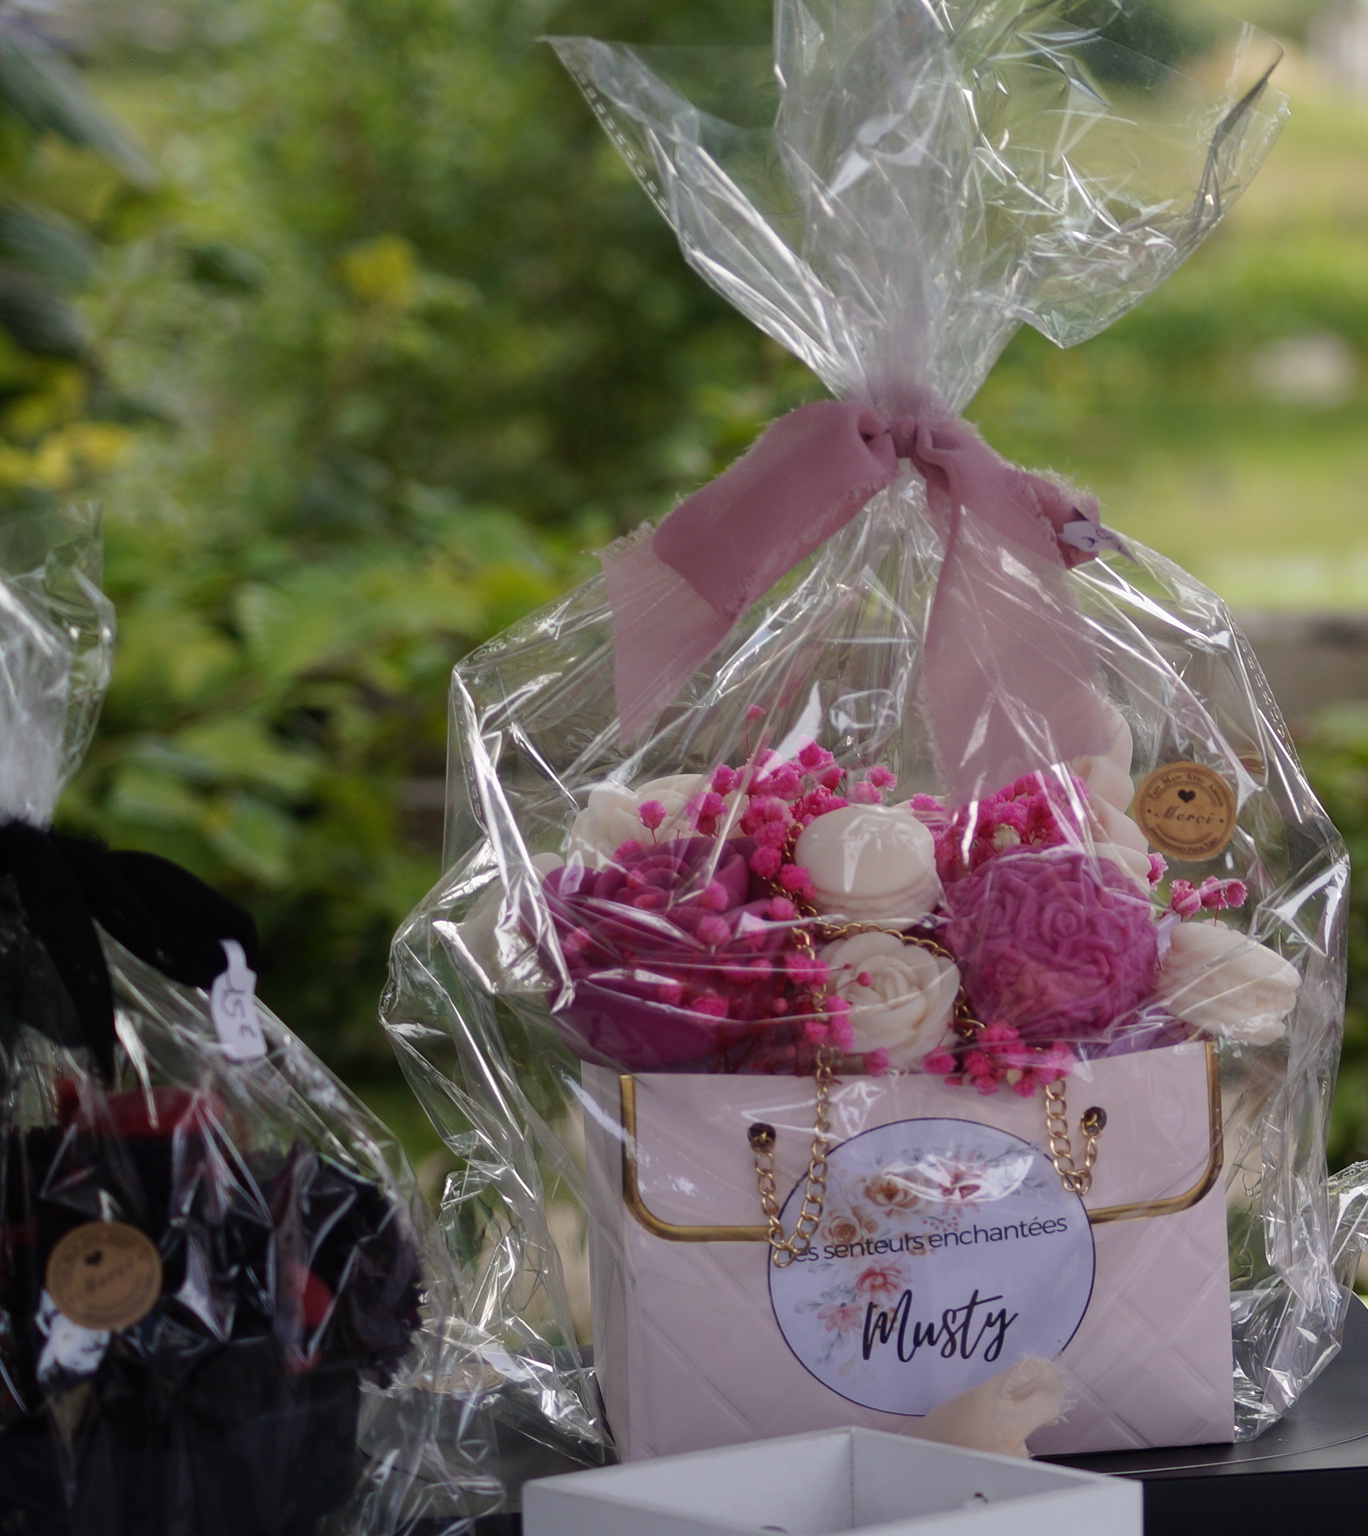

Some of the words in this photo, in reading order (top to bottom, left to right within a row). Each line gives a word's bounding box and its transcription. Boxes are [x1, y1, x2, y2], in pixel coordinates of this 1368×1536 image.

[1154, 805, 1214, 825] Merci
[789, 1246, 819, 1262] es
[824, 1233, 924, 1260] senteurs
[928, 1216, 1068, 1249] enchantées
[862, 1289, 1019, 1363] Musty
